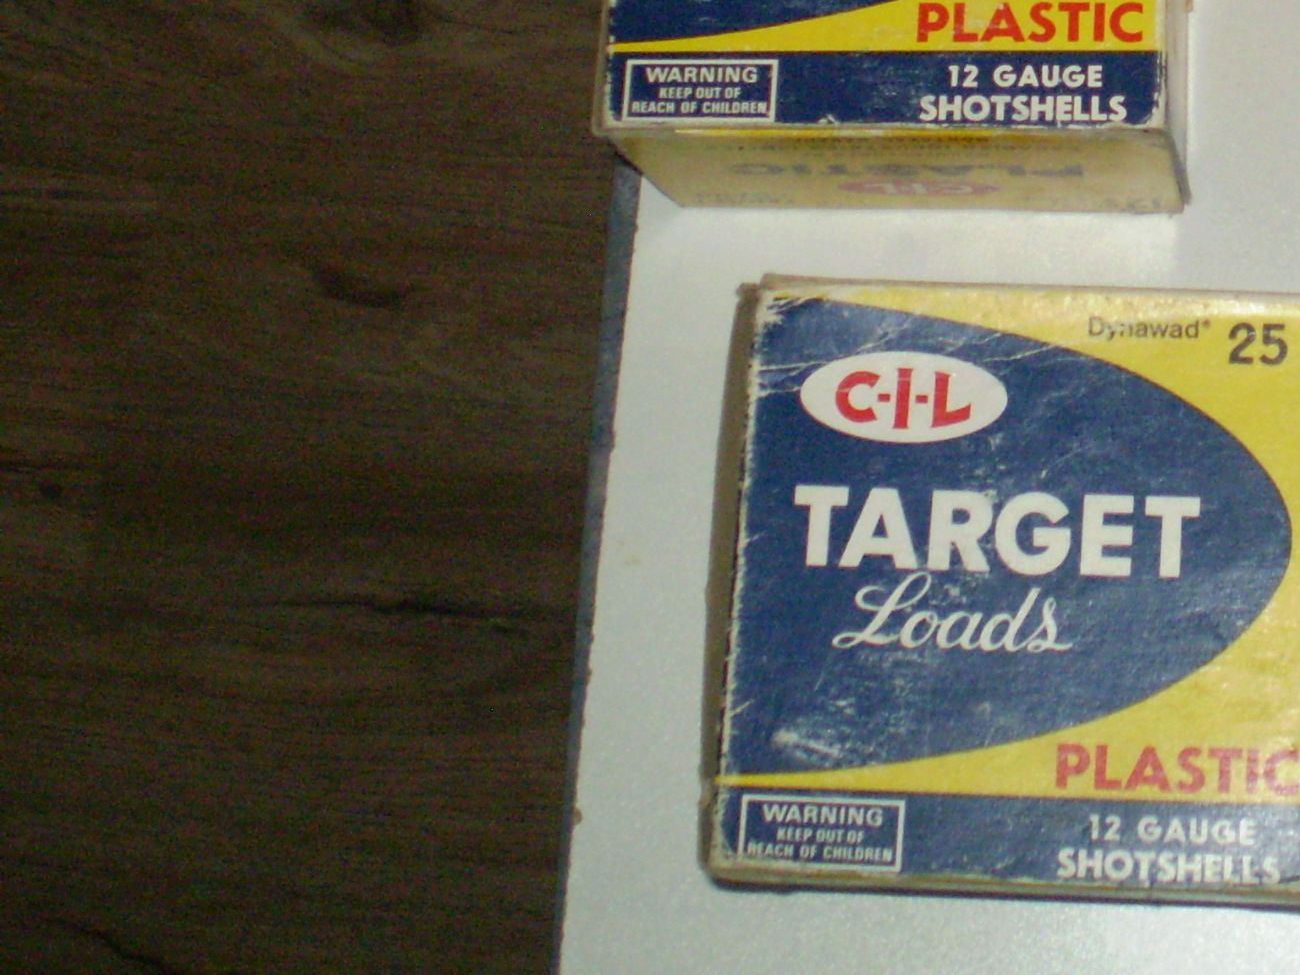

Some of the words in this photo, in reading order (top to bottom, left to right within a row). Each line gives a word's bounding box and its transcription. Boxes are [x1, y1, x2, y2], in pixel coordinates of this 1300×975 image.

[916, 2, 1143, 42] PLASTIC
[646, 67, 758, 83] WARNING
[948, 65, 978, 87] 12
[992, 65, 1102, 88] GAUGE
[659, 87, 692, 99] KEEP
[696, 87, 721, 99] OUT
[726, 87, 741, 99] OF
[631, 102, 674, 113] REACH
[680, 102, 697, 113] OF
[702, 102, 768, 114] CHILDREN
[919, 95, 1127, 121] SHOTSHELLS
[1228, 323, 1288, 365] 25
[835, 367, 971, 429] C-I-L
[794, 485, 1200, 578] TARGET
[832, 572, 1073, 652] Loads
[1055, 743, 1299, 795] PLASTIC
[763, 804, 884, 826] WARNING
[777, 829, 812, 842] KEEP
[816, 830, 843, 843] OUT
[847, 831, 864, 844] OF
[1089, 814, 1121, 841] 12
[1138, 817, 1255, 846] GAUGE
[747, 842, 793, 858] REACH
[800, 844, 817, 859] OF
[822, 845, 893, 862] CHILDREN
[1057, 847, 1281, 884] SHOTSHELLS
